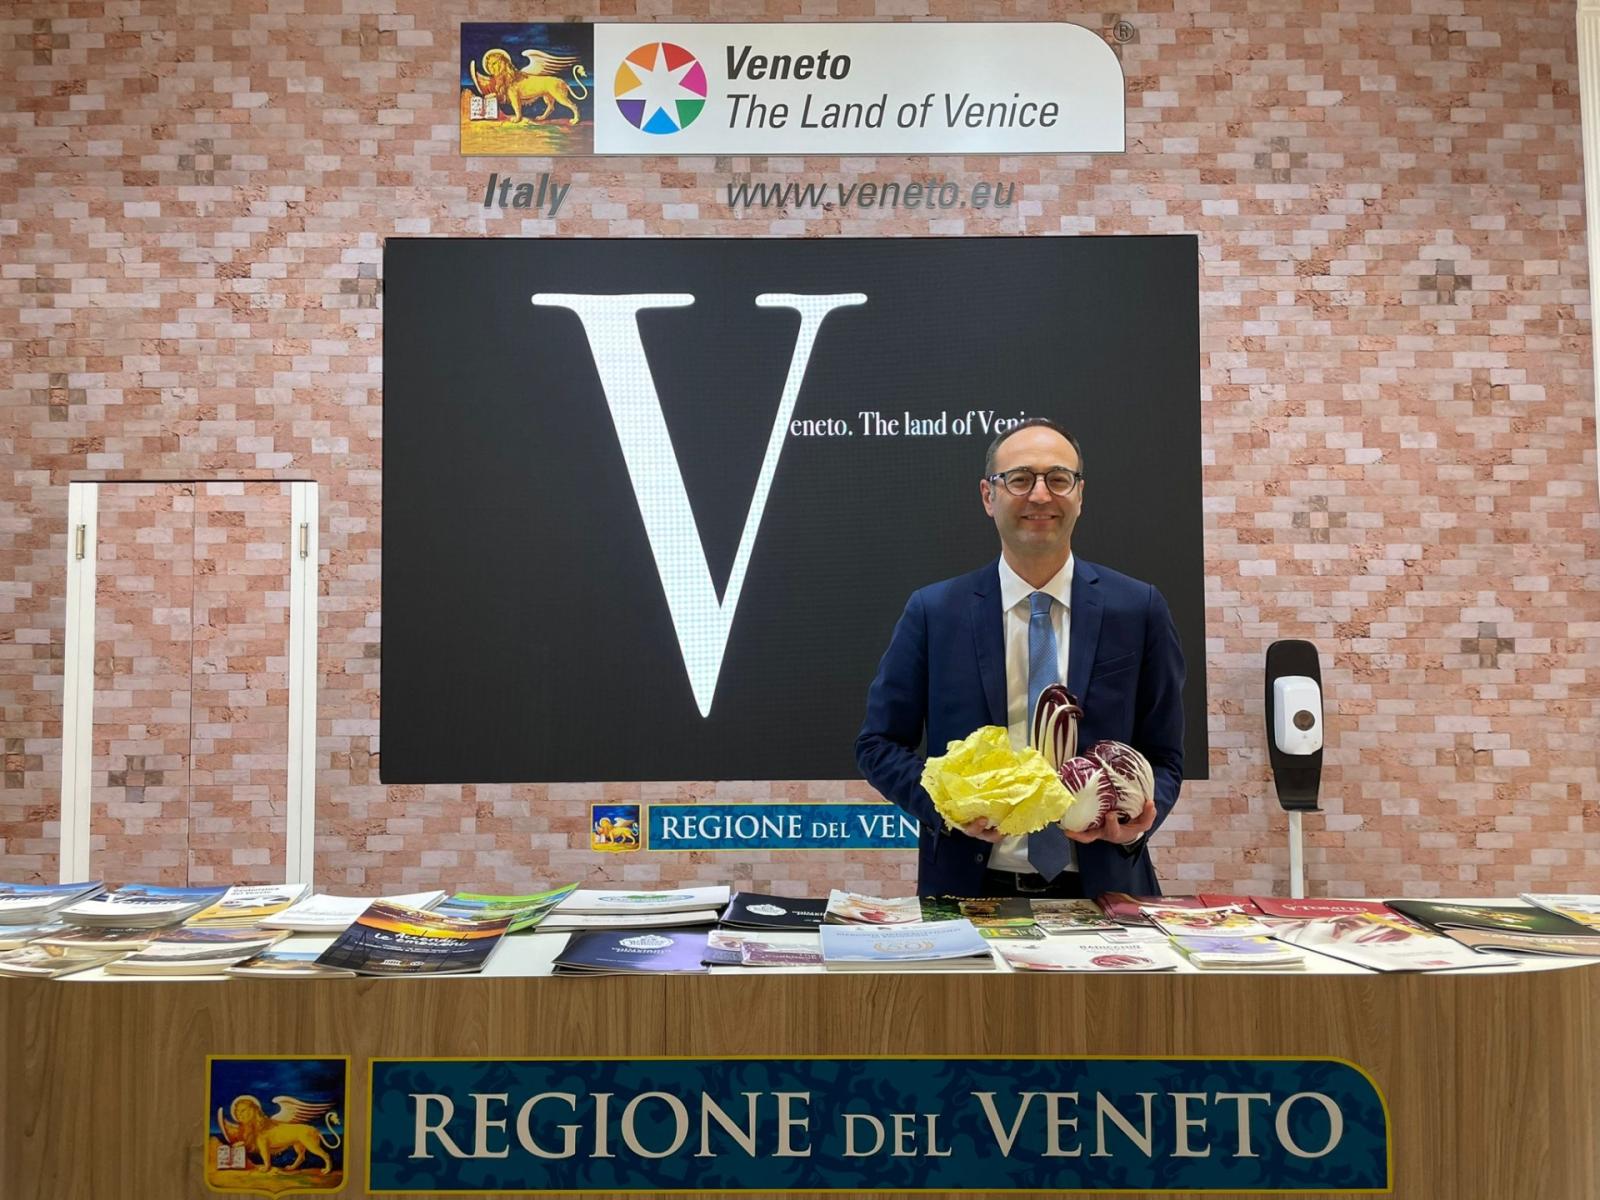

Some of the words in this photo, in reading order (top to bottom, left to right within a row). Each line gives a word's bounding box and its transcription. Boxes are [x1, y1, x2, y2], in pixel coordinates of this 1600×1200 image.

[726, 46, 851, 81] Veneto
[728, 94, 788, 128] The
[800, 94, 883, 129] Land
[898, 93, 934, 128] of
[943, 95, 1059, 128] Venice
[484, 172, 571, 217] Italy
[726, 178, 1015, 210] www.veneto.eu
[858, 411, 899, 436] The
[904, 411, 947, 436] land
[952, 411, 976, 436] of
[661, 814, 803, 839] REGIONE
[811, 822, 851, 838] DEL
[408, 1091, 813, 1159] REGIONE
[841, 1113, 952, 1157] DEL
[971, 1091, 1344, 1158] VENETO
